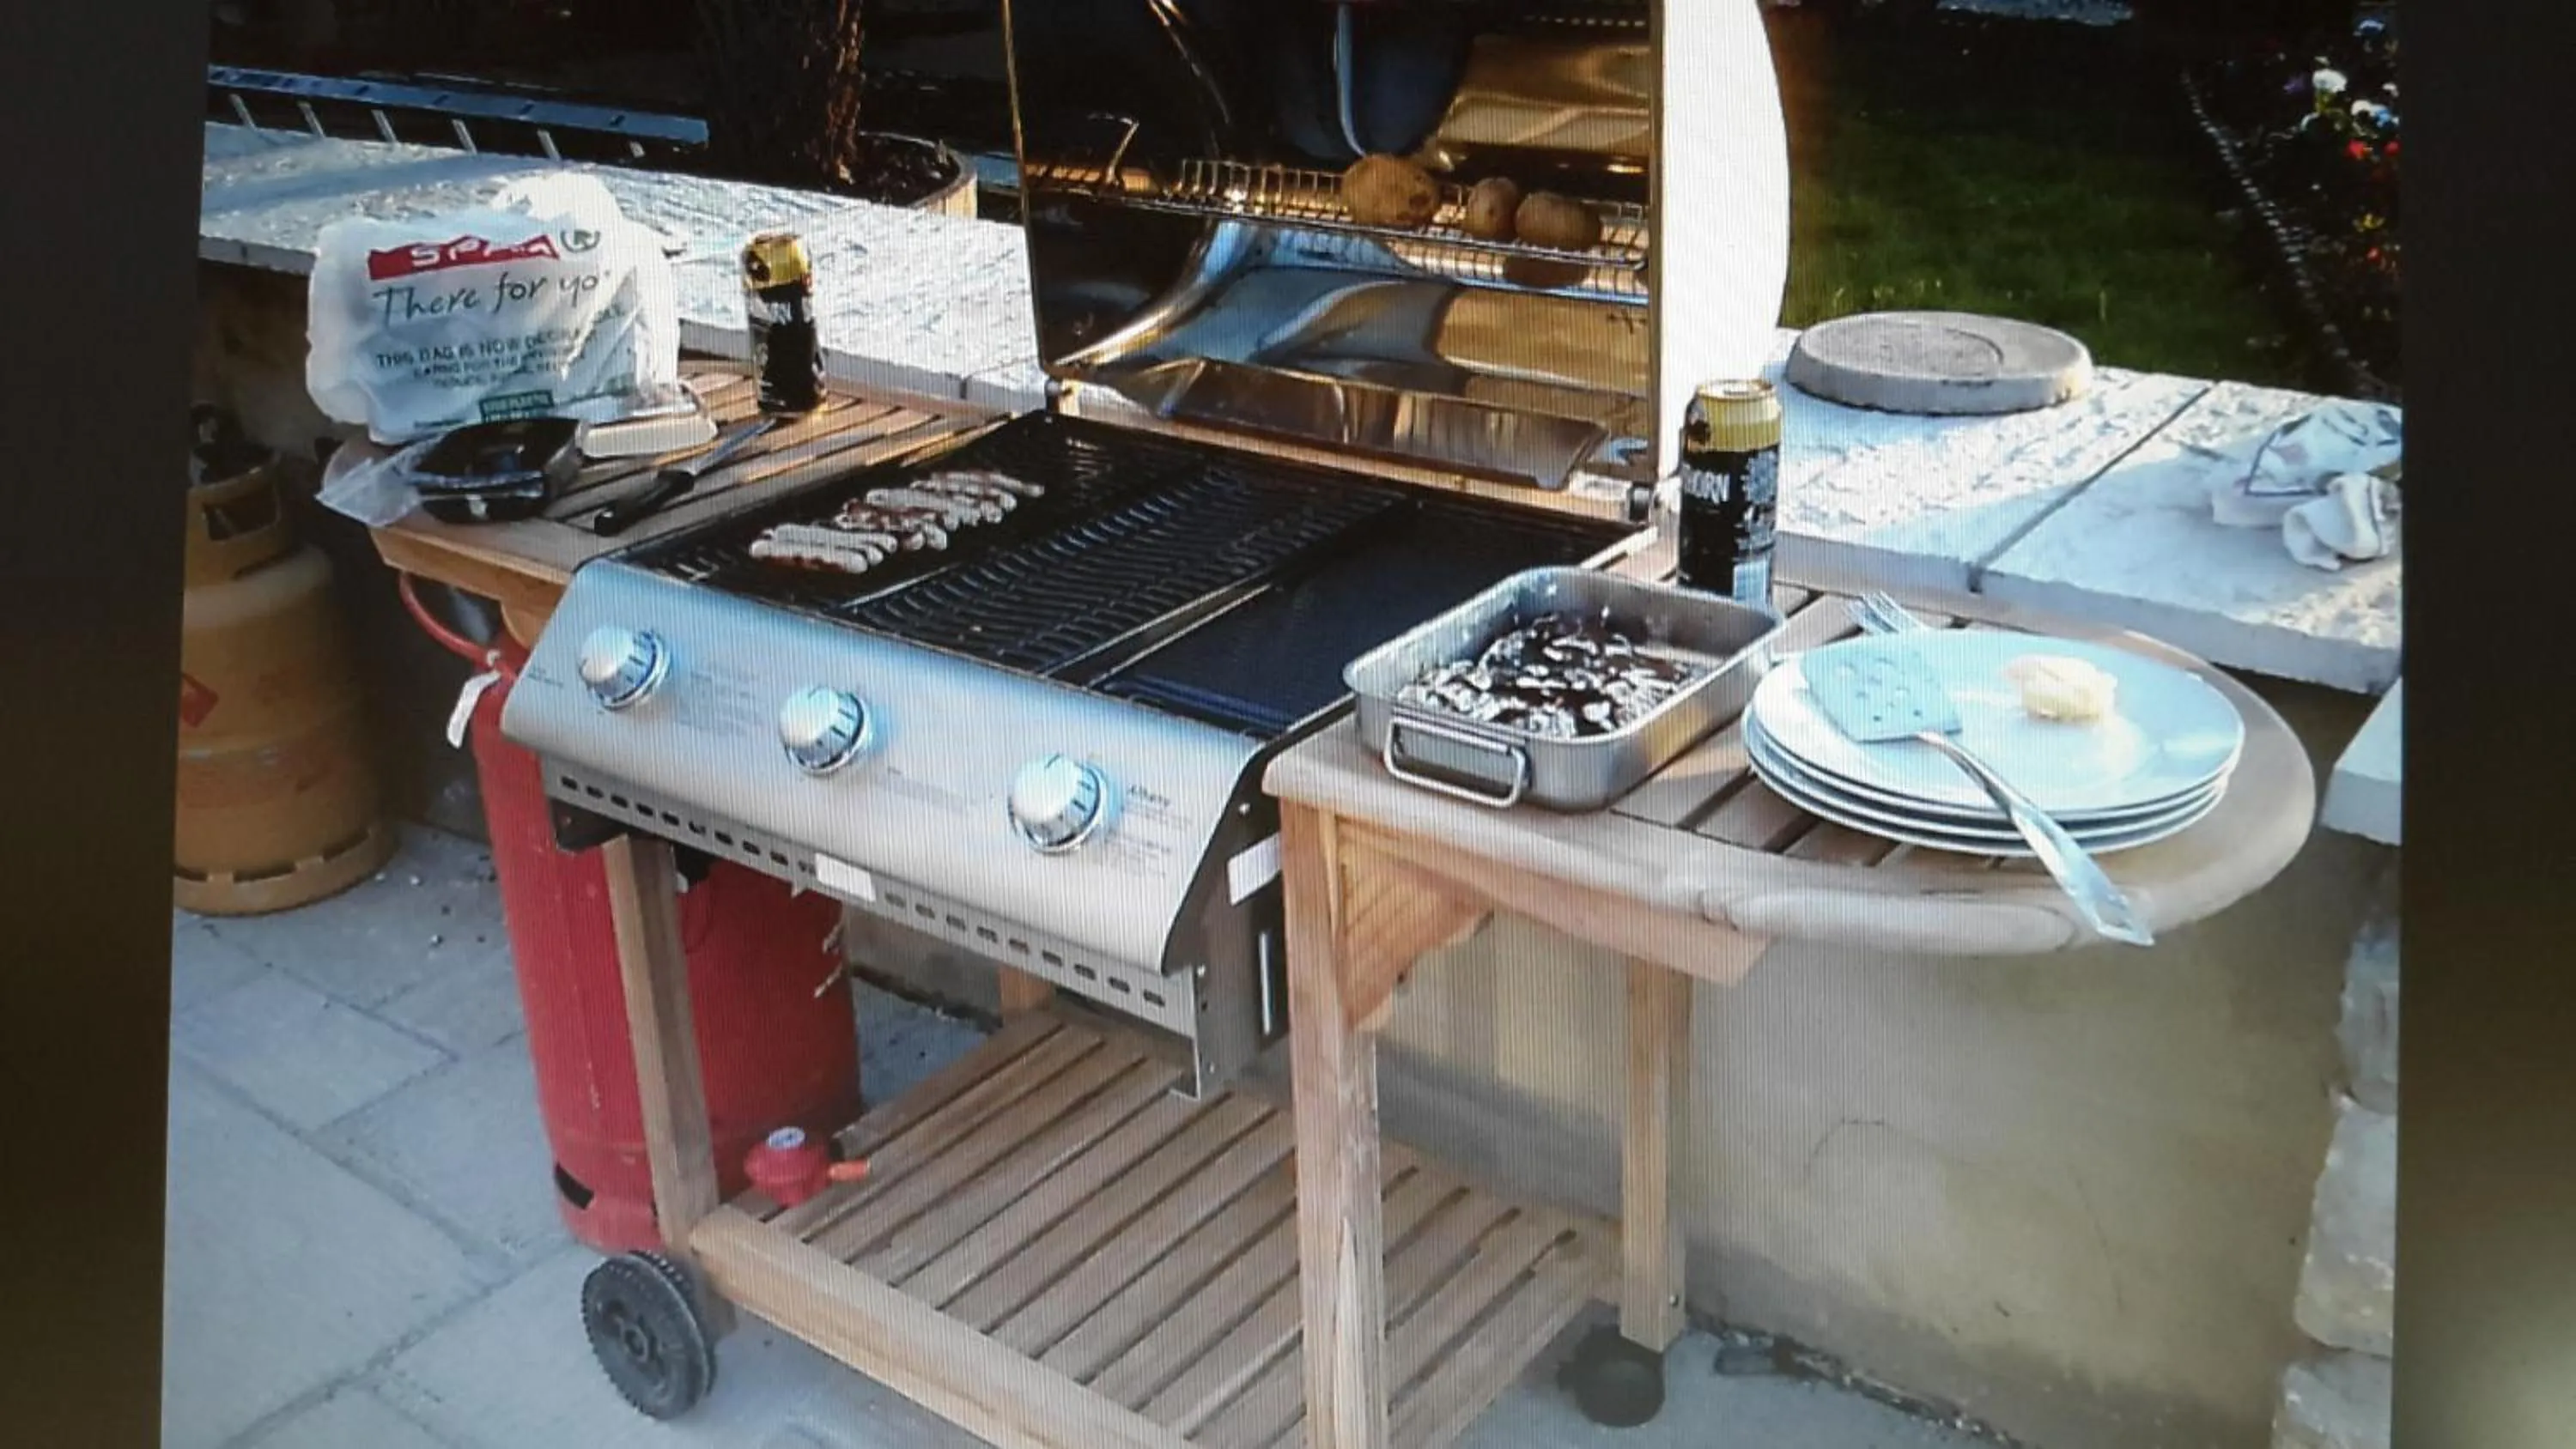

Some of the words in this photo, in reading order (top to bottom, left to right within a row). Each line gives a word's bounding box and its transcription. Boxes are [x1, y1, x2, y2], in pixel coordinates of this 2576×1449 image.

[410, 239, 549, 266] SP
[373, 286, 481, 324] There
[493, 271, 546, 314] for
[419, 345, 455, 362] BAG
[479, 337, 520, 358] NOW
